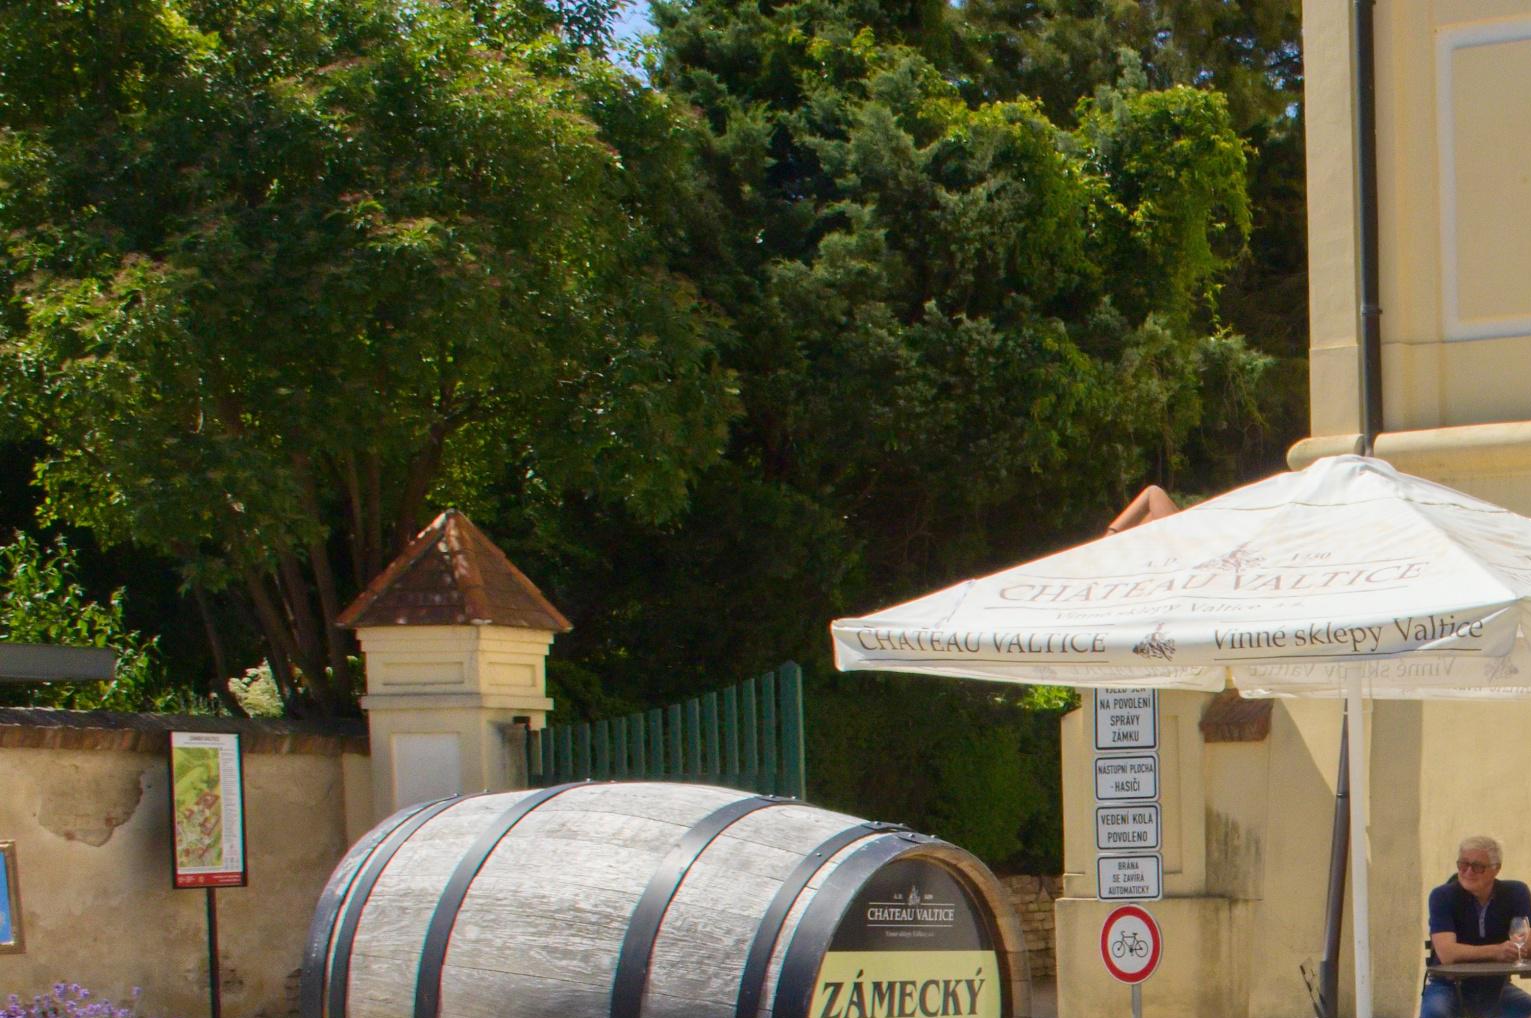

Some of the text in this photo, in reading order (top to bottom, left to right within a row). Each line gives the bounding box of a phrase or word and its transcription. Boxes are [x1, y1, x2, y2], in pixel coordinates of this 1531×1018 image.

[1232, 561, 1429, 591] VALTICE
[992, 631, 1108, 653] VALTICE
[1214, 624, 1286, 650] Vinné
[1294, 621, 1383, 652] sklepy
[1393, 615, 1485, 642] Valtice
[1099, 694, 1151, 710] NA POVOLENÍ
[1110, 711, 1140, 727] SPRÁVY
[1129, 763, 1154, 775] PLOCHA
[1100, 810, 1154, 826] VEDENÍ KOLA
[1107, 831, 1148, 843] POVOLENO
[917, 908, 955, 921] VALTICE
